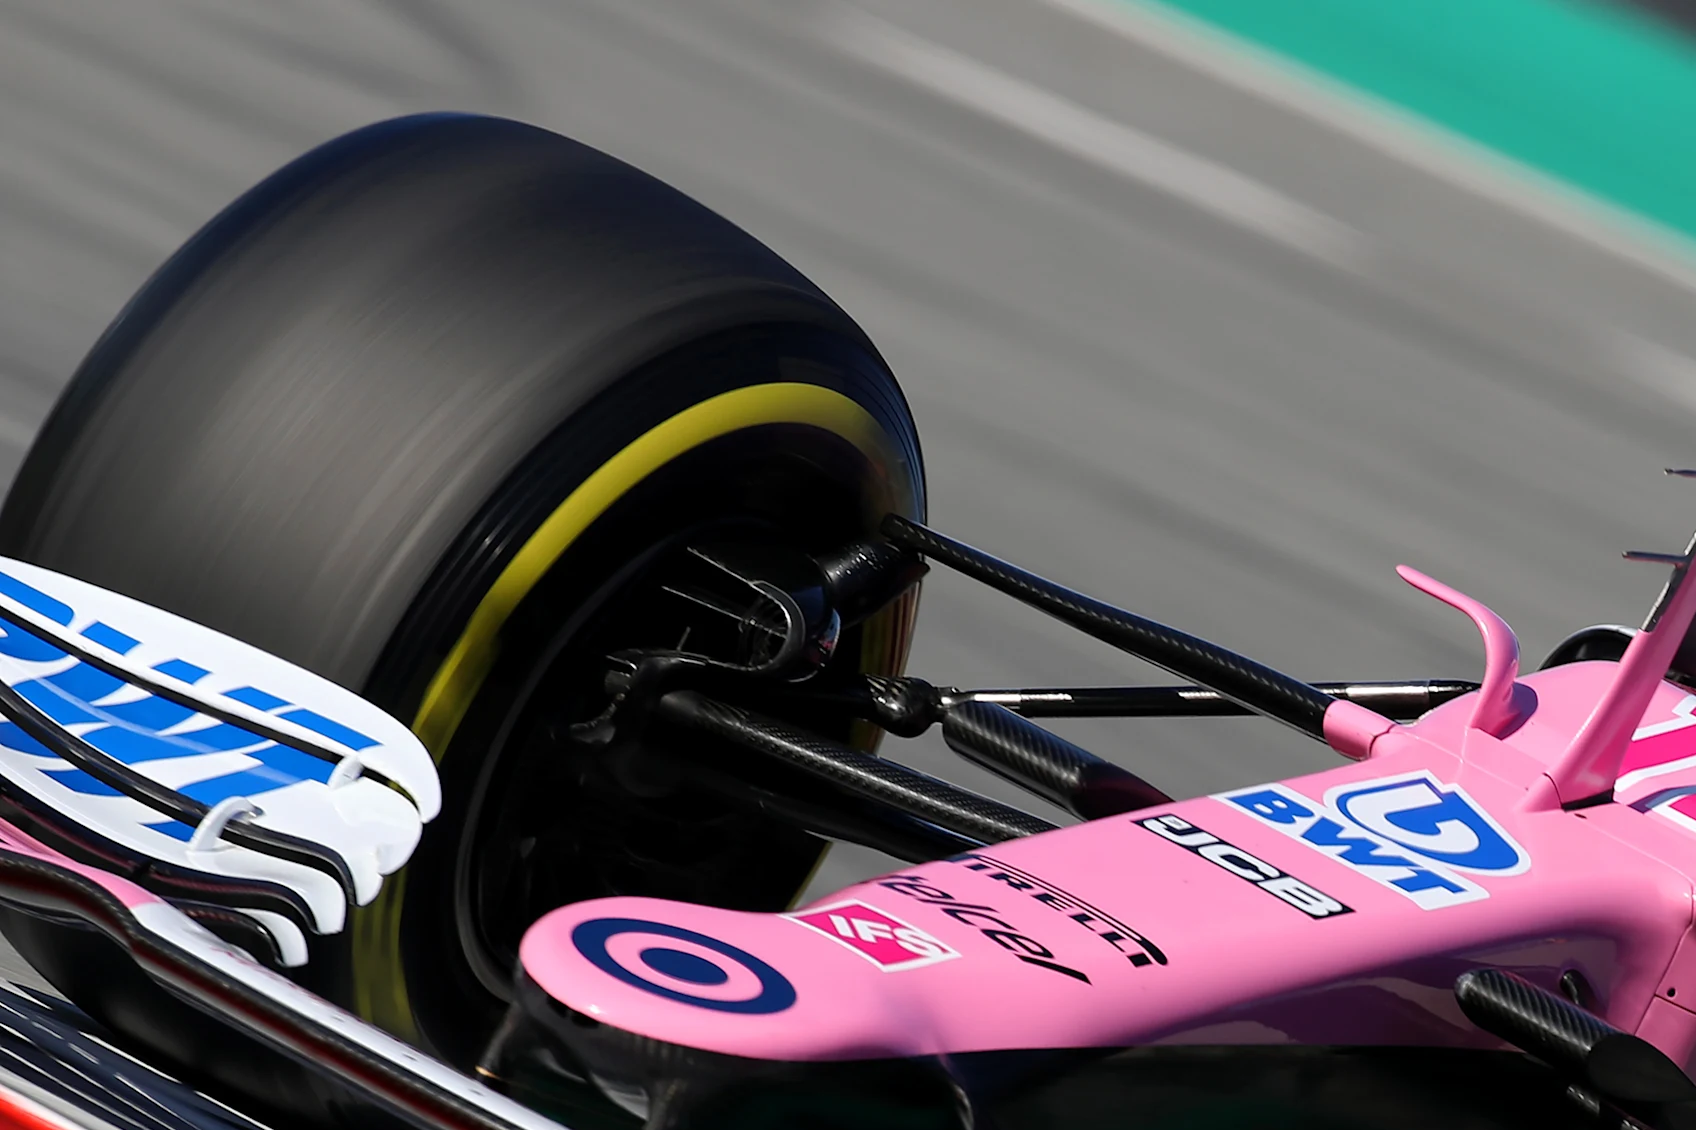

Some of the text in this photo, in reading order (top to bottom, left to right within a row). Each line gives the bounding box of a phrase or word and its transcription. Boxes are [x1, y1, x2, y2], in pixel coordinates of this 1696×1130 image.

[1141, 814, 1346, 917] JCB
[1226, 790, 1468, 894] BWT
[829, 914, 954, 958] IFS
